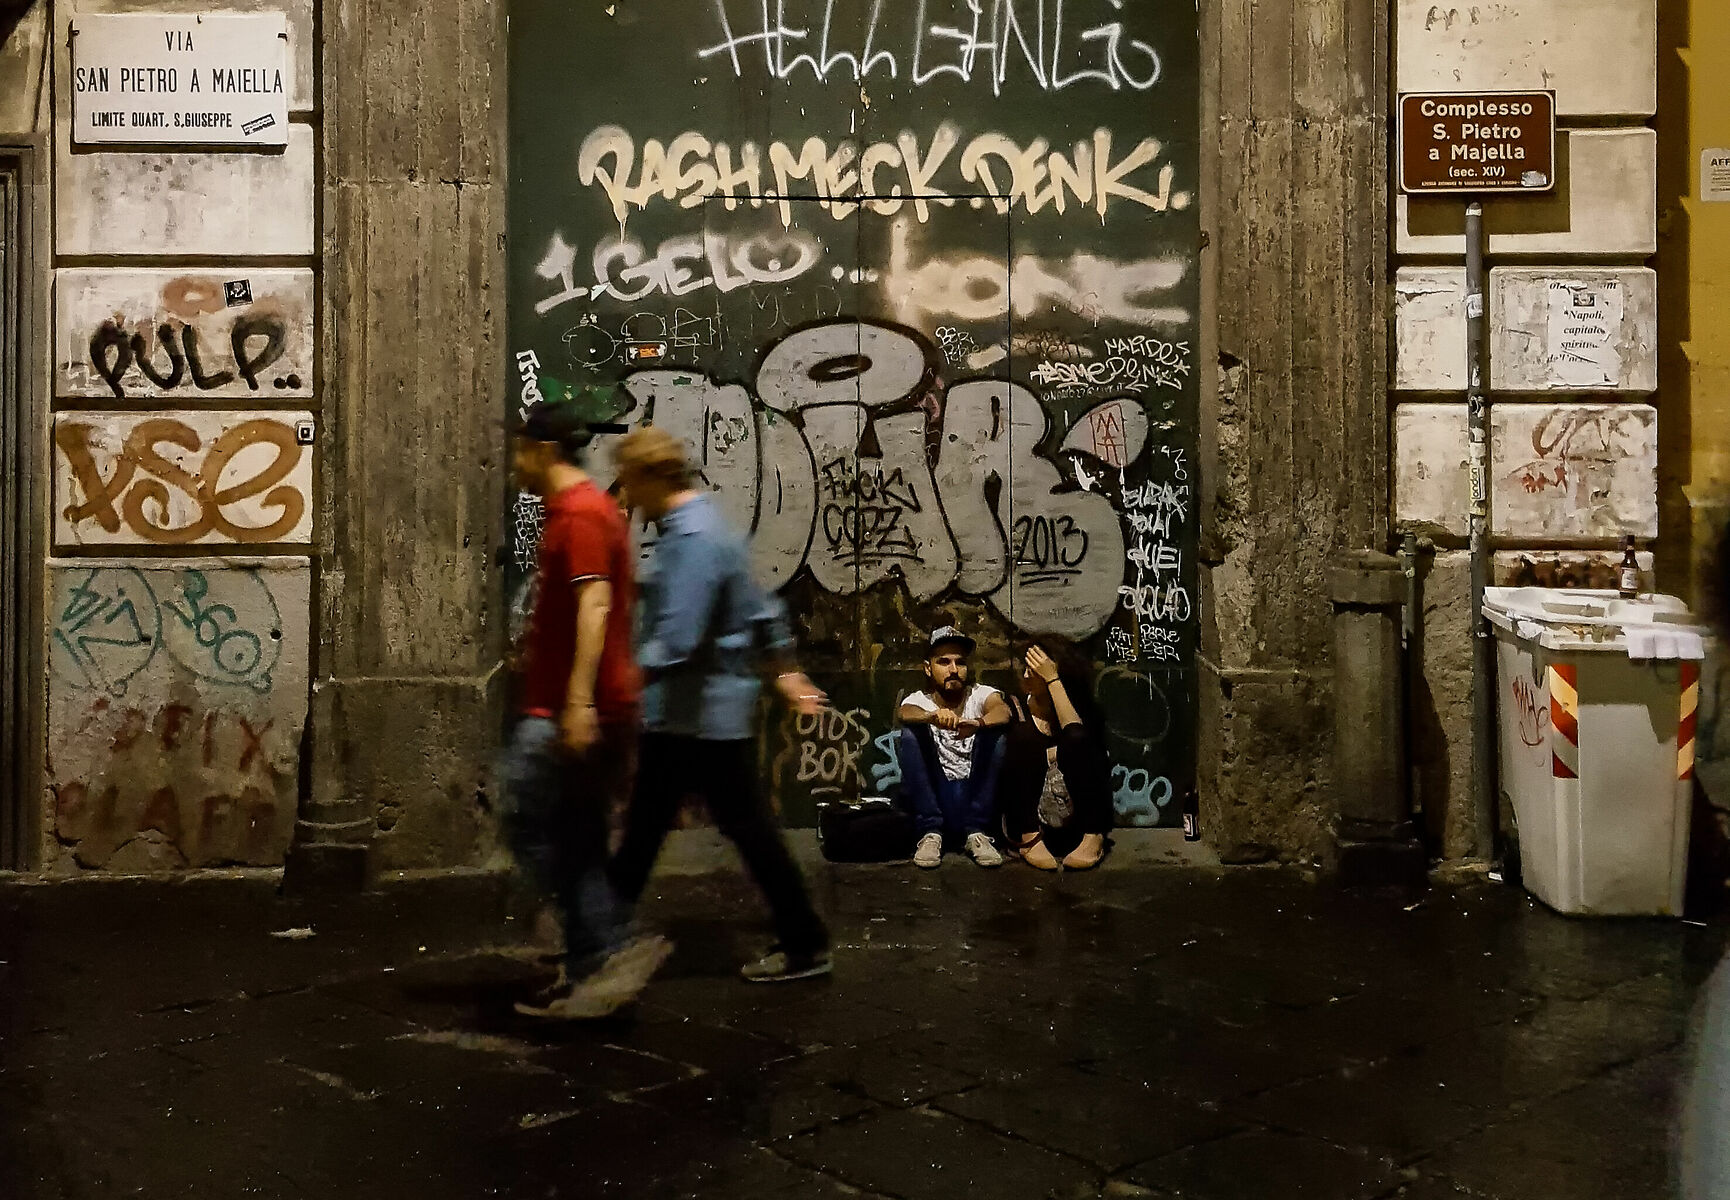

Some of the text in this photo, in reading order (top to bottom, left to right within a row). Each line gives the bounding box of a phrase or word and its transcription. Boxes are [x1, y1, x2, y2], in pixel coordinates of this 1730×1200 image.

[165, 31, 194, 52] VIA
[77, 67, 283, 93] SAN PIETRO A MAIELLA
[1420, 99, 1533, 119] Complesso
[92, 111, 126, 127] LIMITE
[1432, 123, 1522, 140] S. Pietro
[1428, 143, 1526, 162] a Majella
[1449, 166, 1505, 178] (sec. XIV)
[1013, 515, 1089, 568] 2013
